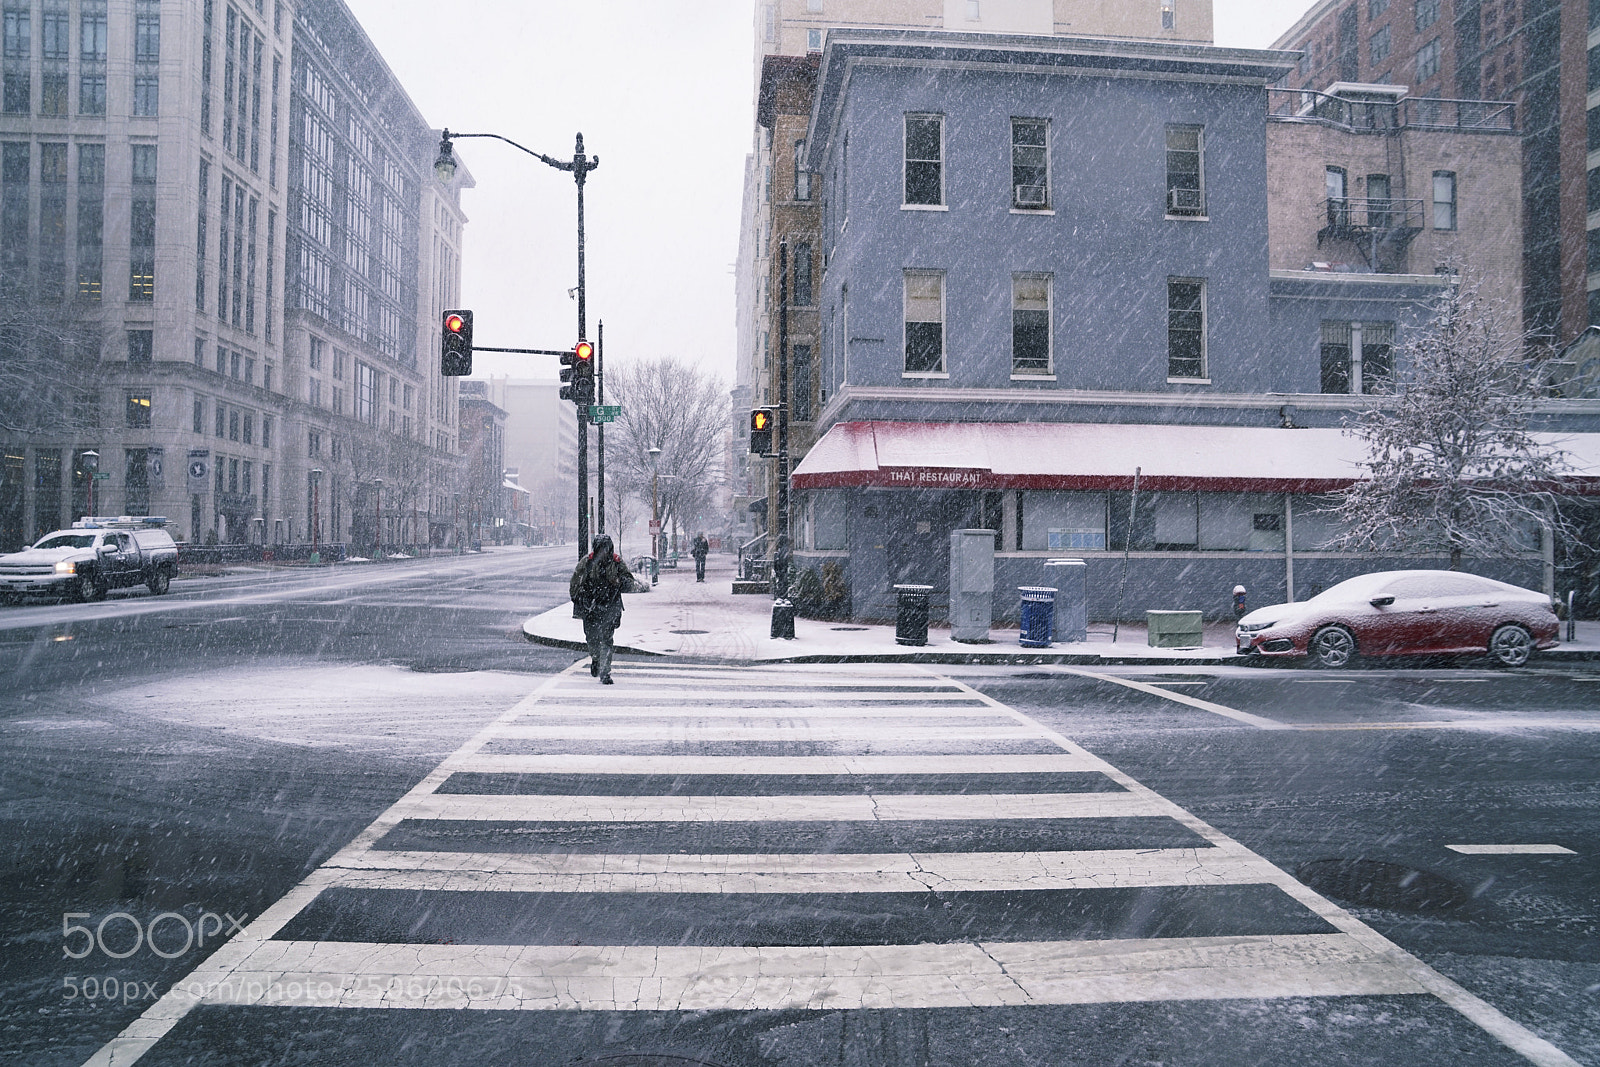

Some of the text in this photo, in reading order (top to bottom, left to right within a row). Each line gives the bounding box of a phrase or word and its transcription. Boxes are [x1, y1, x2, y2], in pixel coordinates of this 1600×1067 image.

[597, 407, 604, 415] G
[890, 471, 981, 483] THAI RESTAURANT
